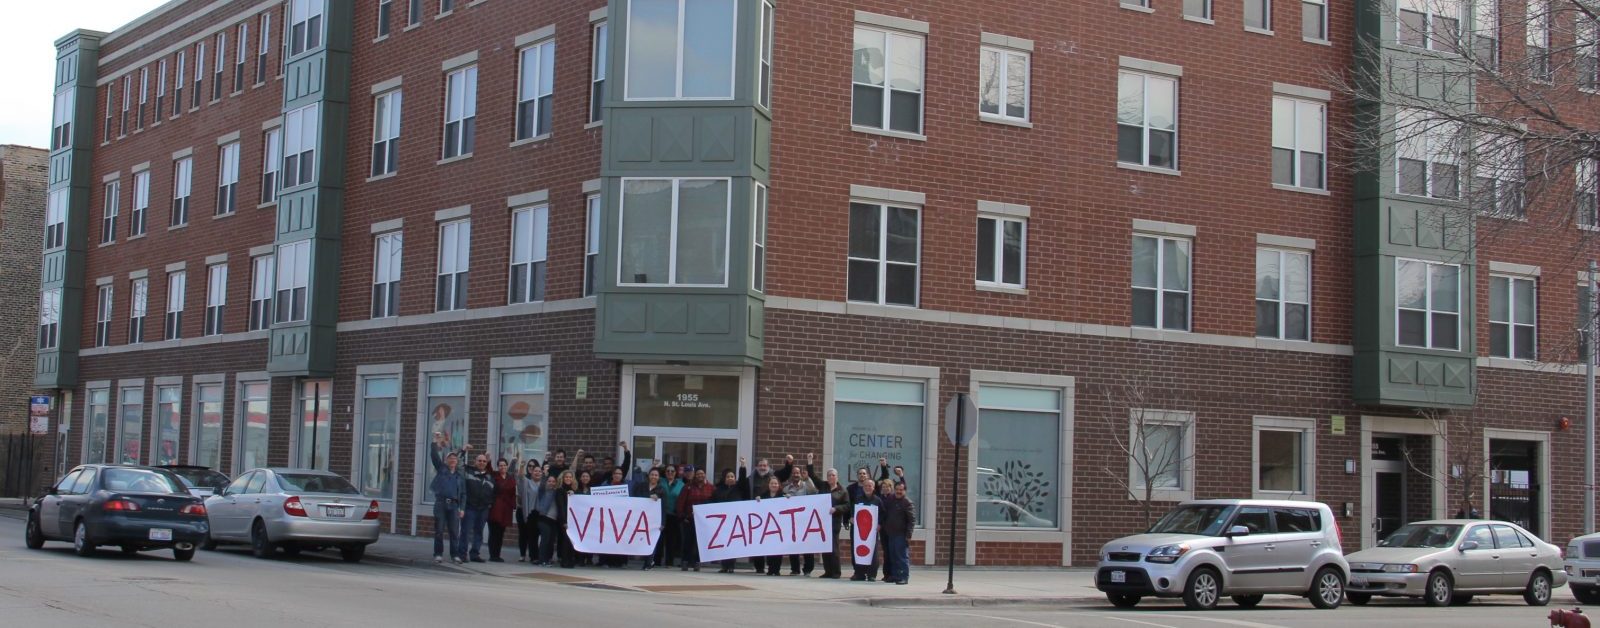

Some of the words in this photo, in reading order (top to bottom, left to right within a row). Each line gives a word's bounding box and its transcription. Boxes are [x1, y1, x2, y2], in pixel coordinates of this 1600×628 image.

[677, 393, 699, 401] 1955
[849, 433, 903, 449] CENTER
[860, 451, 902, 460] CHANGING
[569, 507, 651, 545] VIVA
[705, 507, 826, 550] ZAPATA
